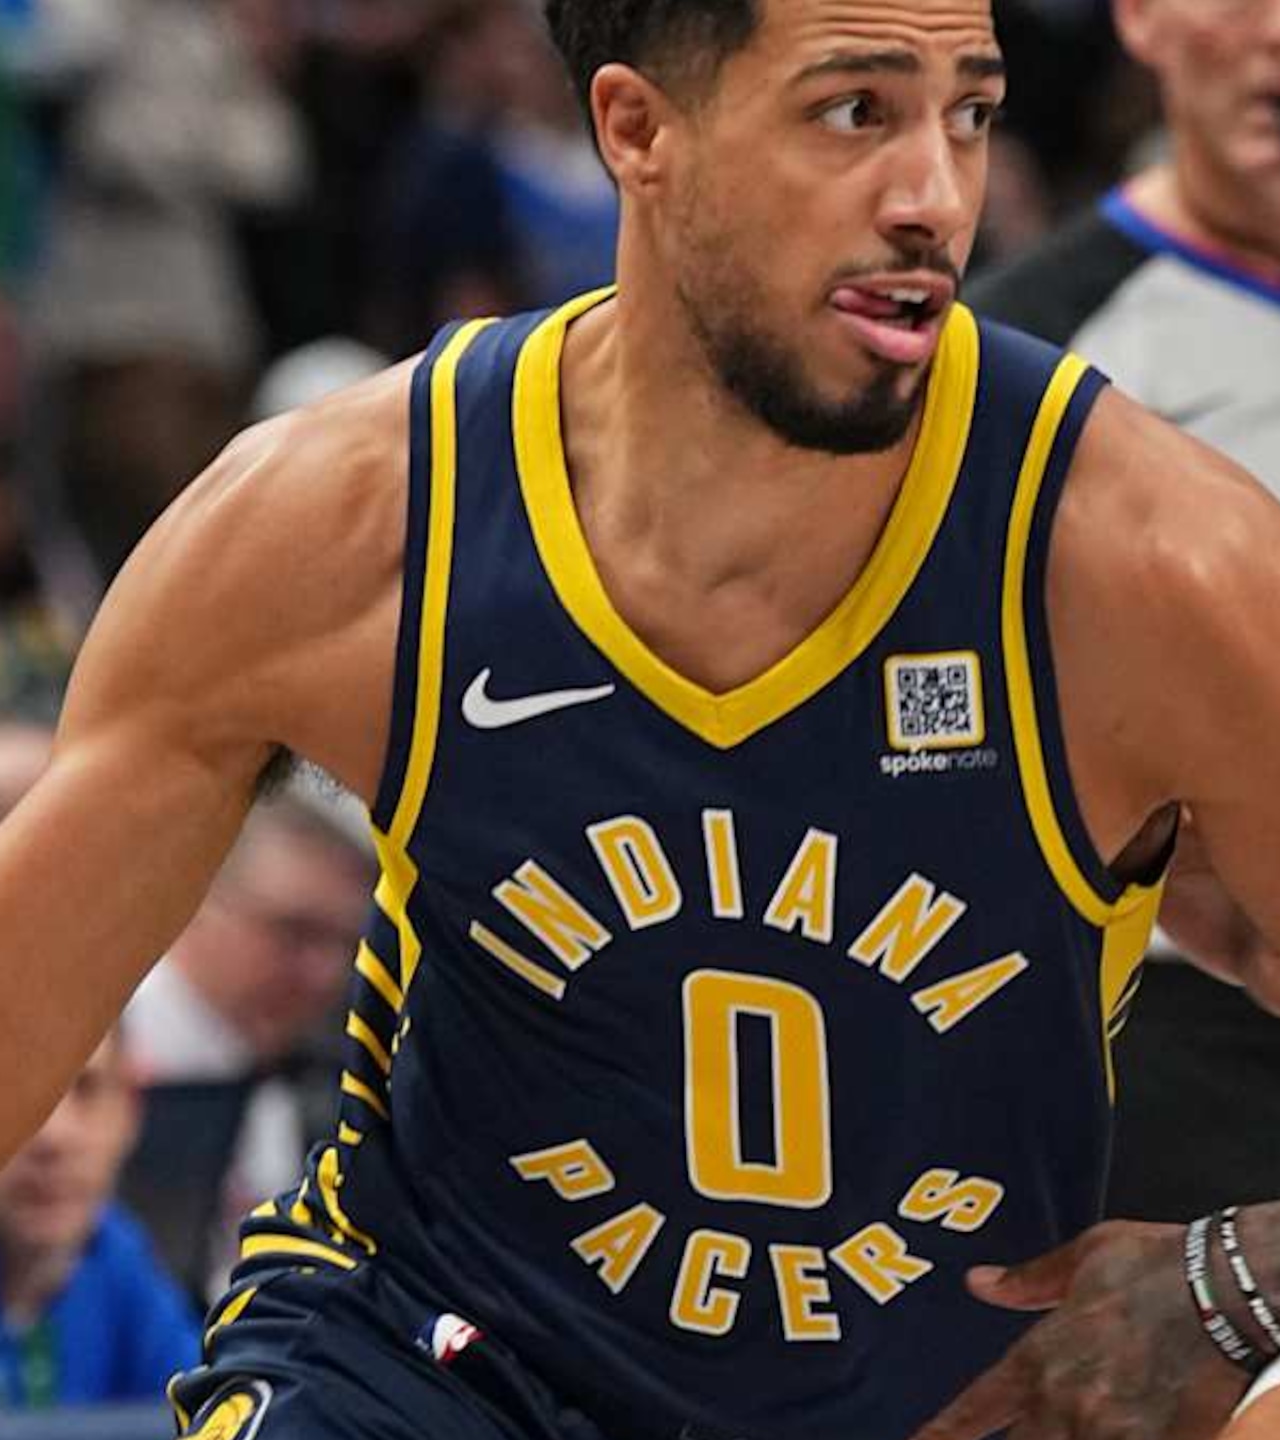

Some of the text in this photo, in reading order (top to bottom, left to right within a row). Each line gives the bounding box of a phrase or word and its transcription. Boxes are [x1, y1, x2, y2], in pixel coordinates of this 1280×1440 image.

[880, 749, 998, 777] spokenote
[470, 808, 1029, 1033] INDIANA
[682, 967, 833, 1208] 0
[508, 1137, 1005, 1342] PACERS
